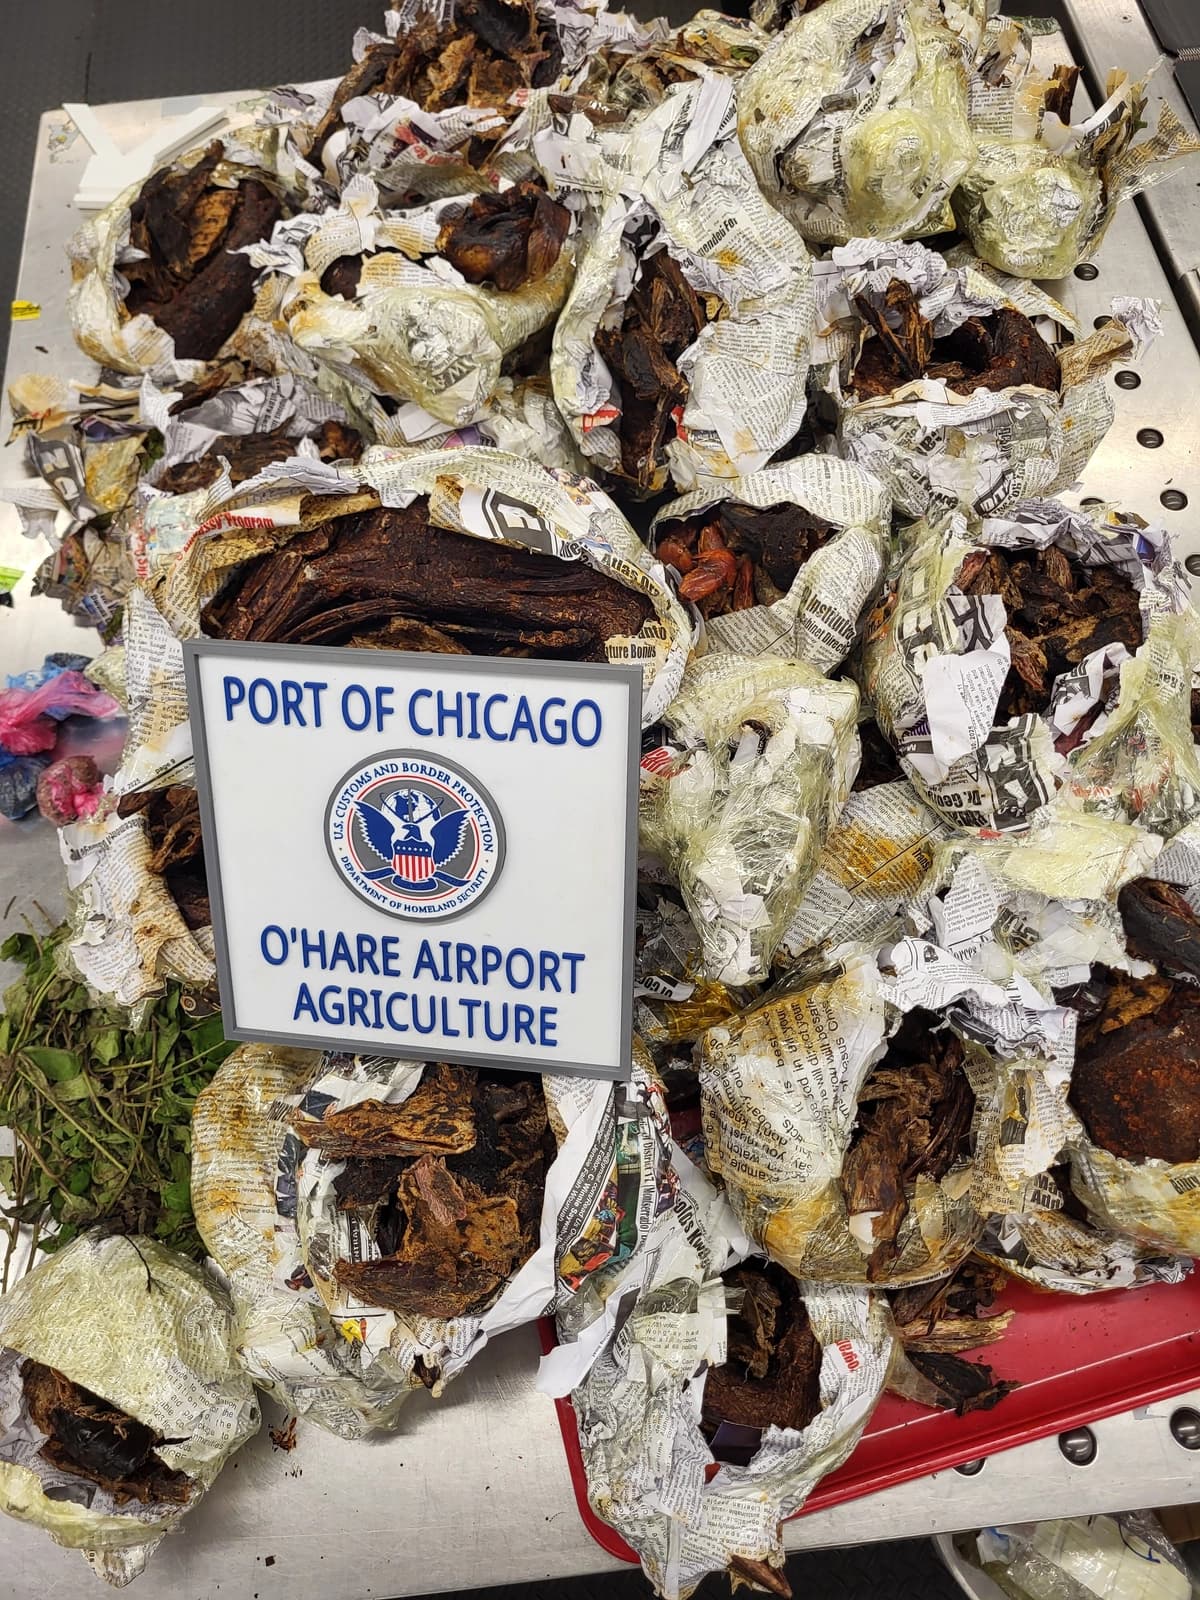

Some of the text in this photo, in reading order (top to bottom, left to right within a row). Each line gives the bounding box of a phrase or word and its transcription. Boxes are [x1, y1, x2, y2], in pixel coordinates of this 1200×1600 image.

[223, 511, 275, 529] Program
[601, 553, 639, 580] Atlas
[631, 643, 657, 659] Bonus
[223, 675, 328, 728] PORT
[341, 684, 395, 732] OF
[408, 688, 601, 748] CHICAGO
[334, 762, 494, 853] U.S. CUSTOMS AND BORDER PROTECTION
[340, 855, 489, 914] DEPARTMENT OF HOMELAND SECURITY
[260, 925, 586, 994] O'HARE AIRPORT
[293, 982, 558, 1047] AGRICULTURE
[769, 1037, 785, 1068] best
[719, 1104, 788, 1147] don't know
[727, 1142, 761, 1164] watch
[762, 1144, 786, 1163] you
